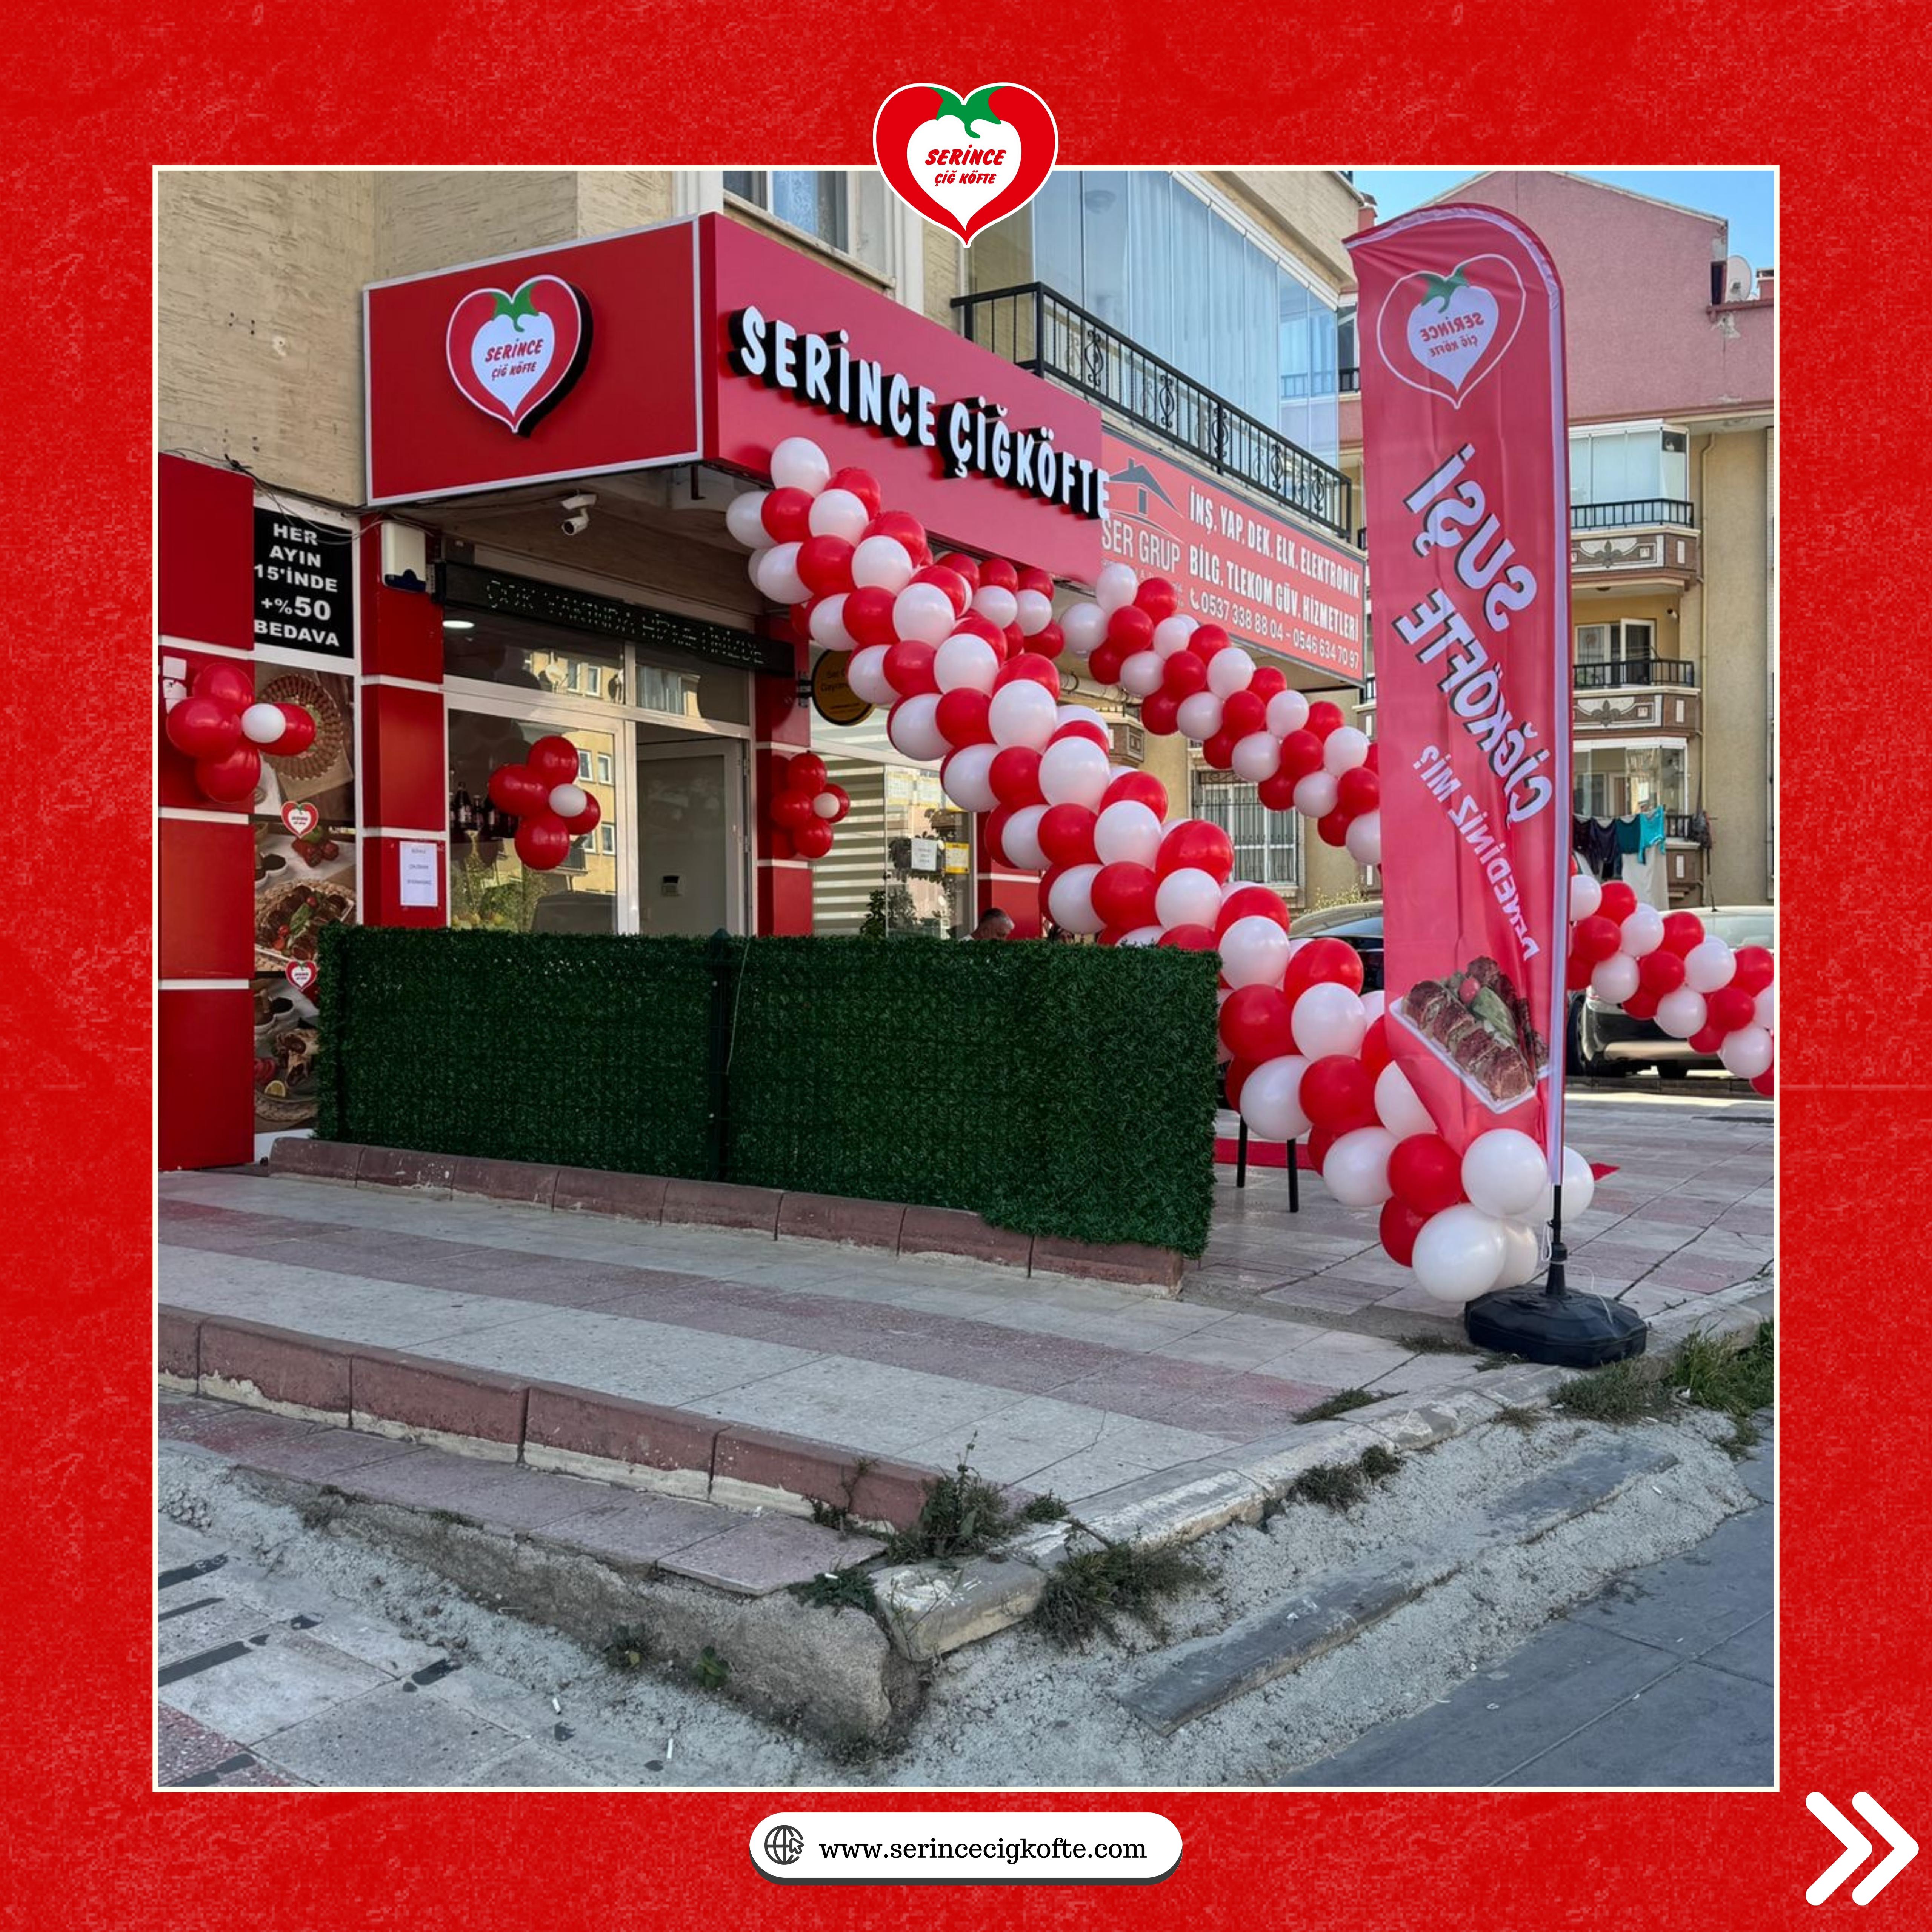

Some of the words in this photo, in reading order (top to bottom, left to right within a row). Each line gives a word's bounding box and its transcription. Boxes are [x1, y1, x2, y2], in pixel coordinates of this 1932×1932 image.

[485, 338, 544, 363] SERİNCE
[509, 361, 537, 377] KÖFTE
[741, 306, 936, 446] SERİNCE
[949, 395, 1109, 519] ÇİĞKÖFTE
[273, 523, 318, 545] HER
[1190, 485, 1217, 535] İNŞ.
[1220, 505, 1244, 545] YAP.
[1248, 519, 1274, 558] DEK.
[1276, 533, 1298, 570] ELK.
[269, 545, 321, 568] AYIN
[1101, 519, 1133, 558] SER
[1140, 529, 1180, 574] GRUP
[254, 564, 338, 592] 15'İNDE
[1190, 543, 1224, 587] BİLG.
[1226, 560, 1273, 608] TLEKOM
[1276, 581, 1301, 619] GÜV.
[261, 596, 331, 621] +%50
[254, 619, 340, 647] BEDAVA
[1201, 591, 1230, 621] 0537
[1232, 603, 1252, 630] 338
[1254, 612, 1268, 636] 88
[1269, 618, 1283, 641] 04
[1293, 628, 1318, 655] 0546
